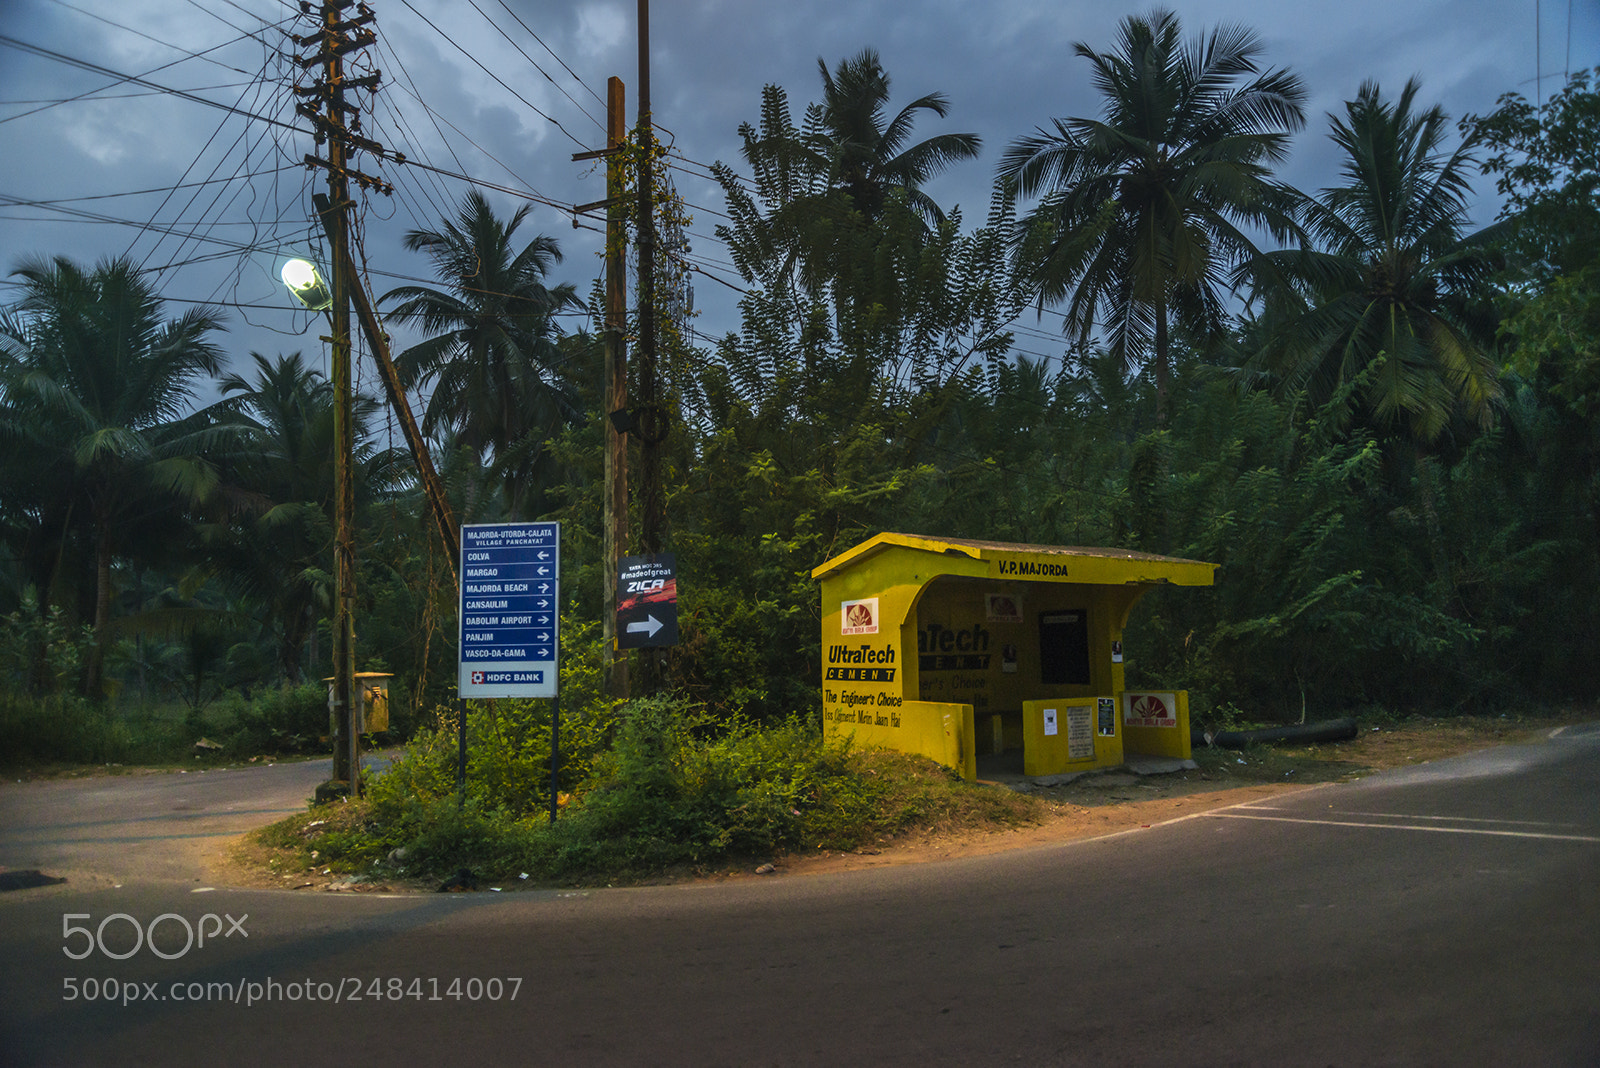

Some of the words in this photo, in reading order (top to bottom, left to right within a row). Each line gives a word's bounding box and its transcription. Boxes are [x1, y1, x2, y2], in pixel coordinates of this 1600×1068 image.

[467, 529, 552, 539] MAJORDA-UTORDA-CALATA
[467, 553, 490, 561] COLVA
[467, 568, 498, 577] MARGAO
[621, 569, 671, 580] #madeofgreat
[466, 584, 502, 593] MAJORDA
[504, 584, 528, 592] BEACH
[626, 579, 665, 593] ZICA
[466, 600, 508, 609] CANSAULIM
[466, 617, 498, 625] DABOLIM
[501, 616, 532, 625] AIRPORT
[465, 633, 494, 642] PANJIM
[465, 649, 526, 658] VASCO-DA-GAMA
[828, 644, 895, 664] UltraTech
[514, 673, 540, 681] BANK
[828, 669, 894, 680] CEMENT
[825, 689, 837, 703] The
[841, 690, 875, 708] Engineer's
[877, 692, 903, 707] Choice
